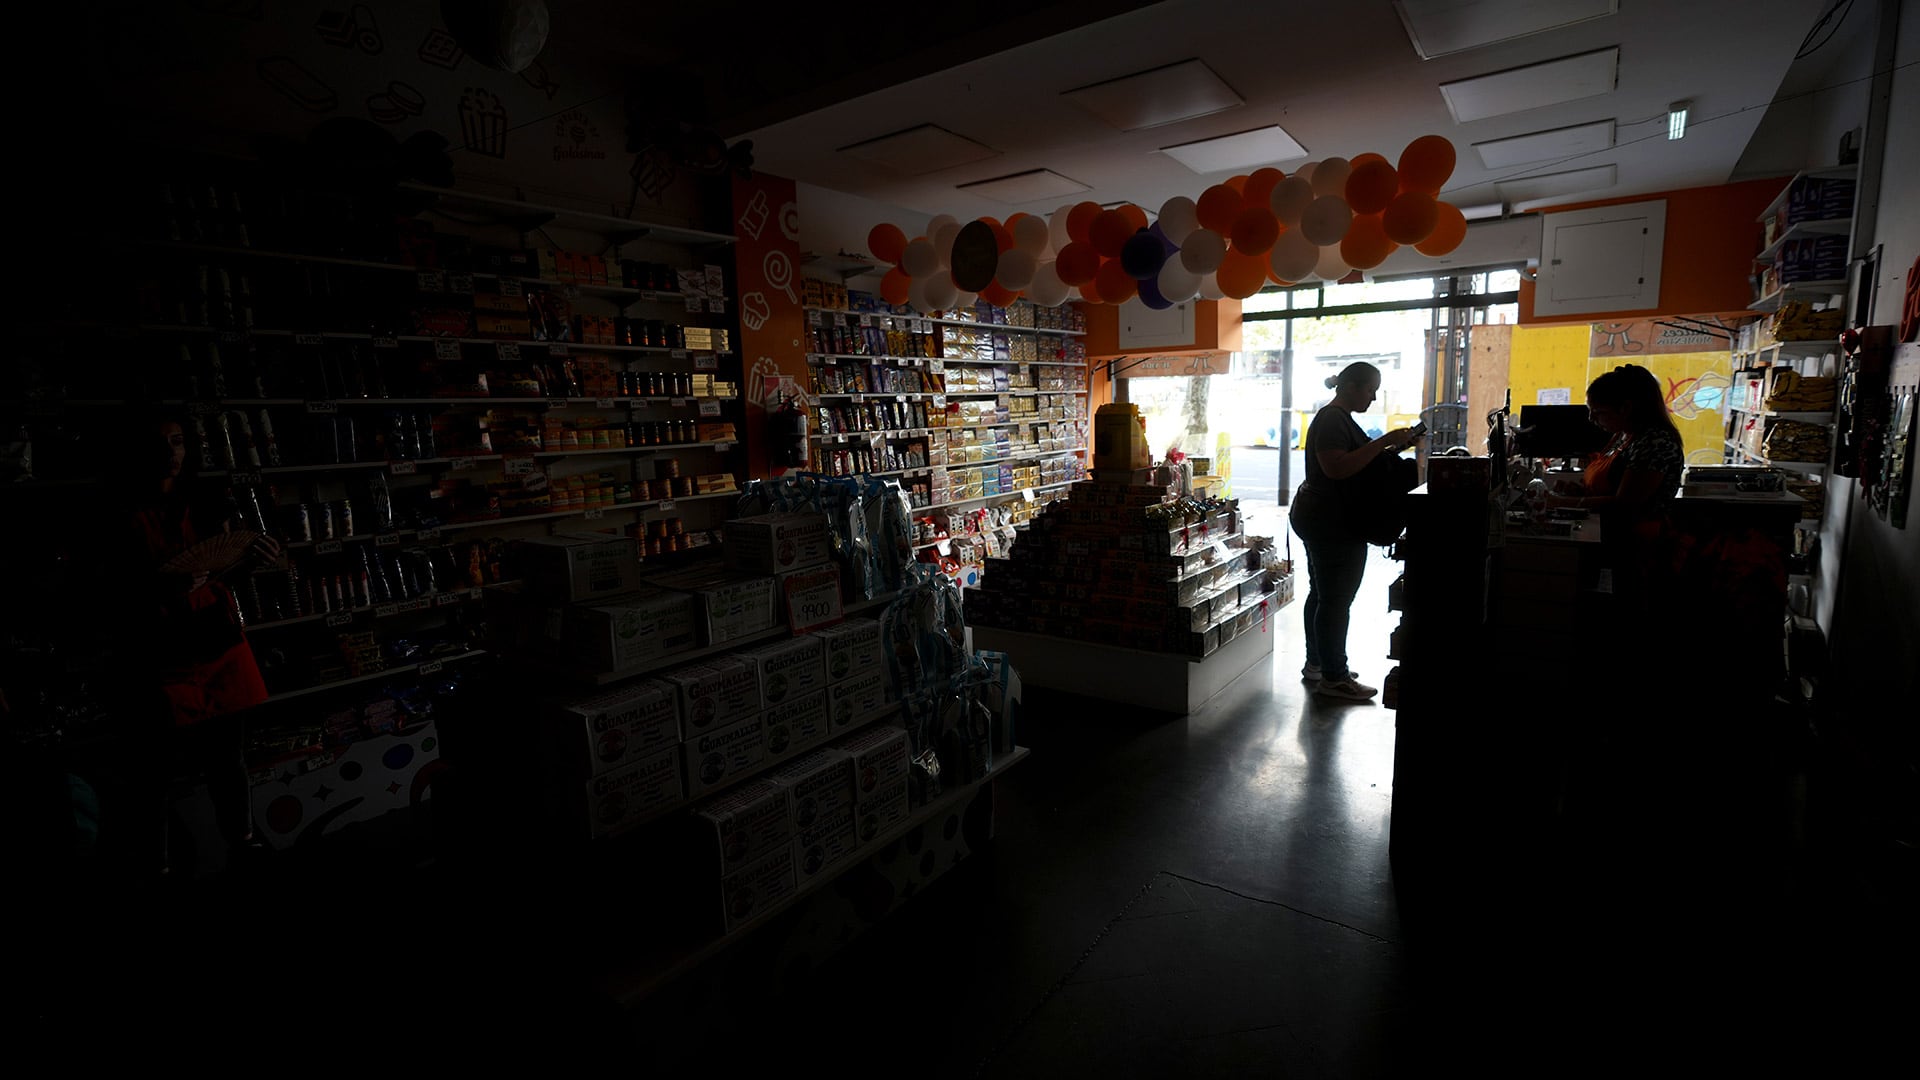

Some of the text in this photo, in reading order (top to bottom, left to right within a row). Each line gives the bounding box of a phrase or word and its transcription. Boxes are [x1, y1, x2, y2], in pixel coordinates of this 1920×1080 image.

[689, 665, 755, 699] GUAYMALLEN
[594, 694, 673, 732] GUAYMALLEN
[698, 718, 762, 753] GUAYMALLEN
[594, 753, 673, 796] GUAYMALLEN
